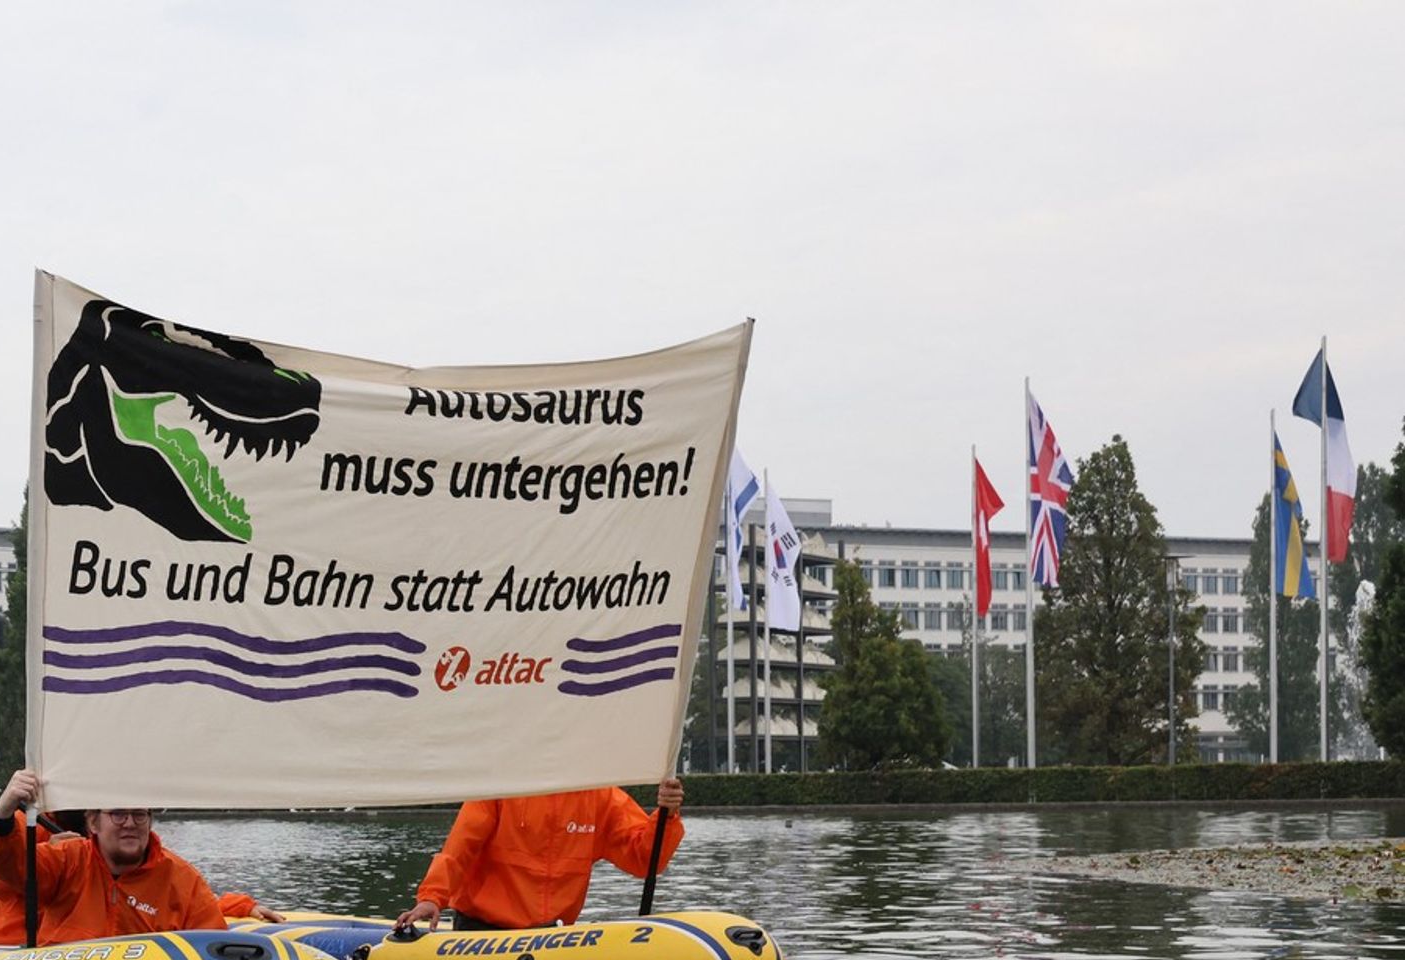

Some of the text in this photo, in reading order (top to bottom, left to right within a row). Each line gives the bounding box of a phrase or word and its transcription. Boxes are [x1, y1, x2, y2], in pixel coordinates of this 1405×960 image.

[404, 386, 645, 426] Autosaurus
[320, 446, 696, 515] muss untergehen!
[68, 540, 671, 613] Bus und Bahn statt Autowahn
[474, 652, 553, 685] attac
[122, 942, 148, 960] 3
[436, 926, 654, 956] CHALLENGER 2
